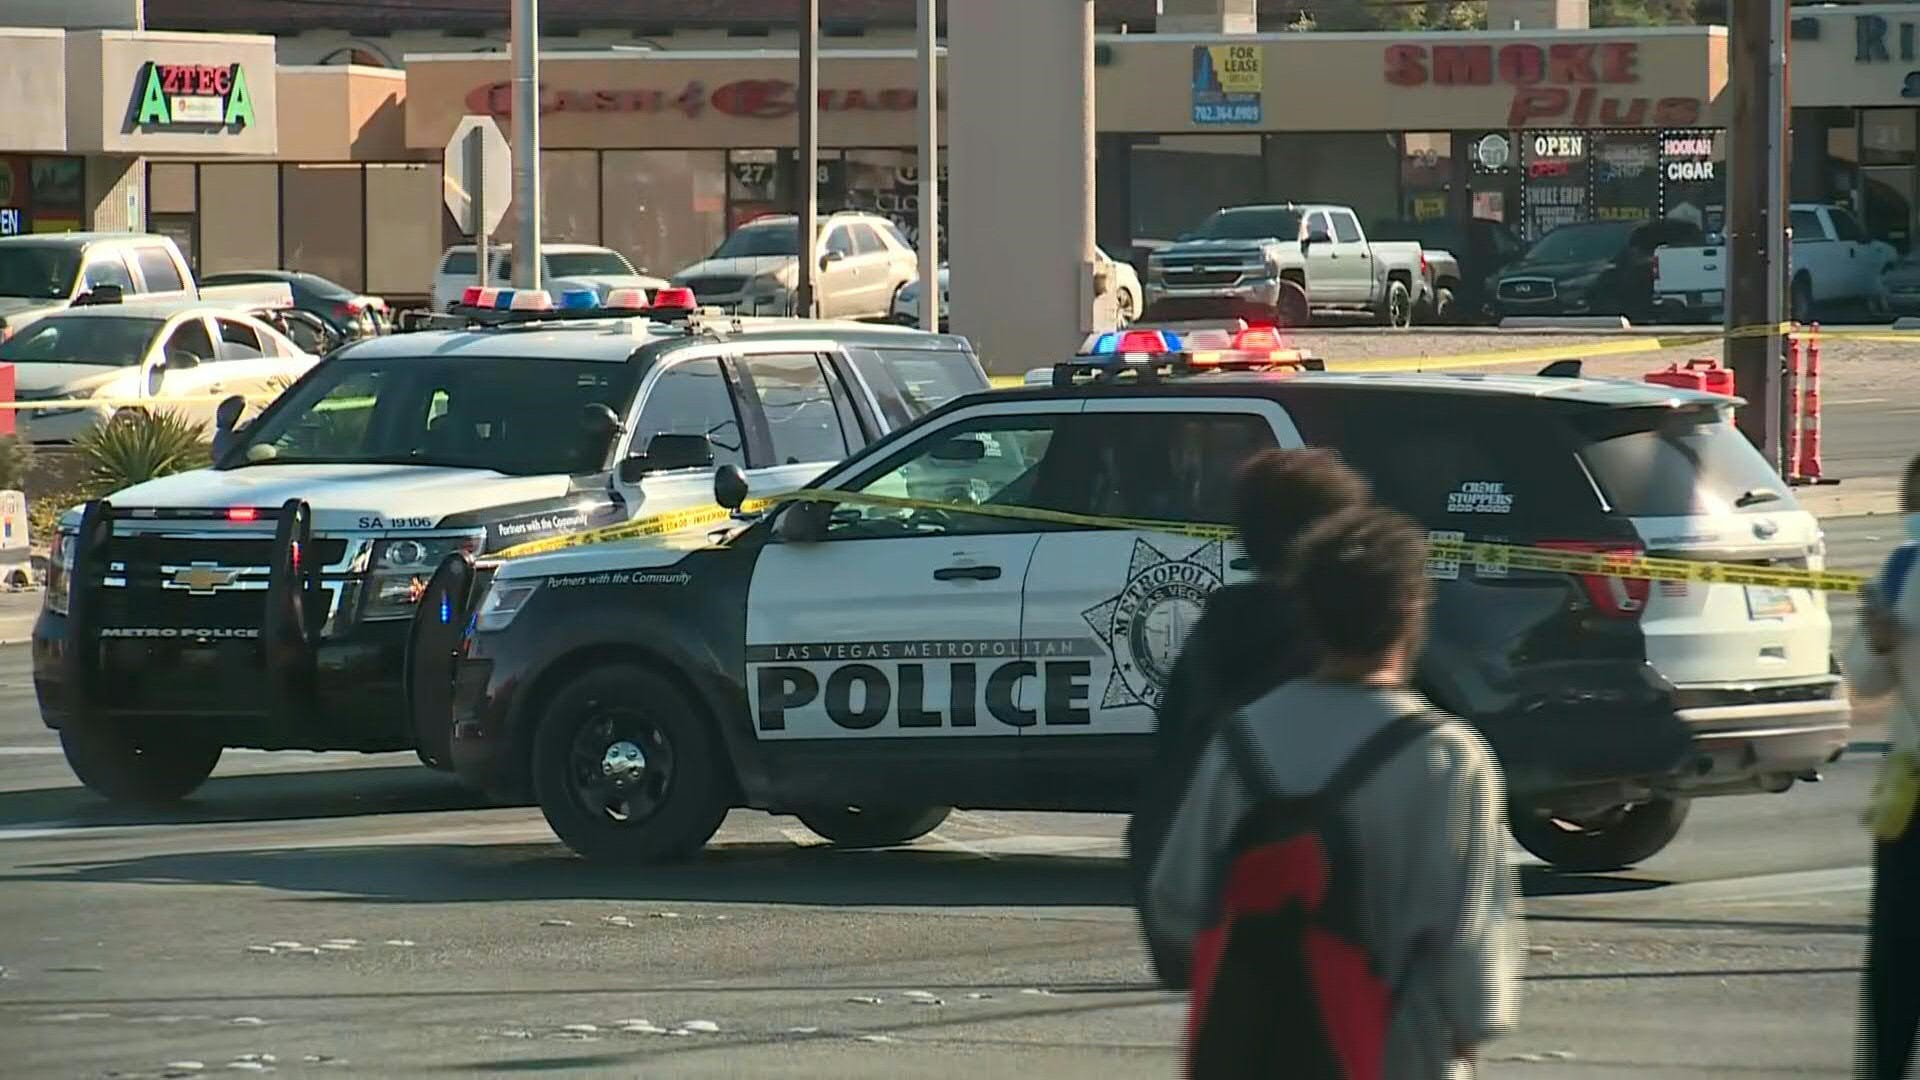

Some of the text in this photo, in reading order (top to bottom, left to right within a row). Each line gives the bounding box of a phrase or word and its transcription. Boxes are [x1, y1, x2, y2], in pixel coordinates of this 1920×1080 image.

[1230, 47, 1254, 59] FOR
[1225, 59, 1257, 72] LEASE
[1384, 43, 1638, 86] SMOKE
[139, 62, 255, 128] AZTECA
[1508, 87, 1699, 128] Plus
[1535, 136, 1582, 156] OPEN
[1664, 139, 1711, 156] HOOKAH
[739, 166, 765, 182] 27
[818, 166, 829, 182] 8
[1667, 161, 1715, 181] CIGAR
[0, 209, 18, 236] EN
[1447, 493, 1513, 504] STOPPERS
[359, 517, 431, 528] SA 19106
[499, 522, 525, 537] Partners
[526, 520, 540, 532] with
[541, 519, 552, 530] the
[547, 571, 692, 588] Partners with the Community
[101, 627, 259, 638] METRO POLICE
[774, 640, 1074, 660] LAS VEGAS METROPOLITAN
[757, 660, 1091, 731] POLICE
